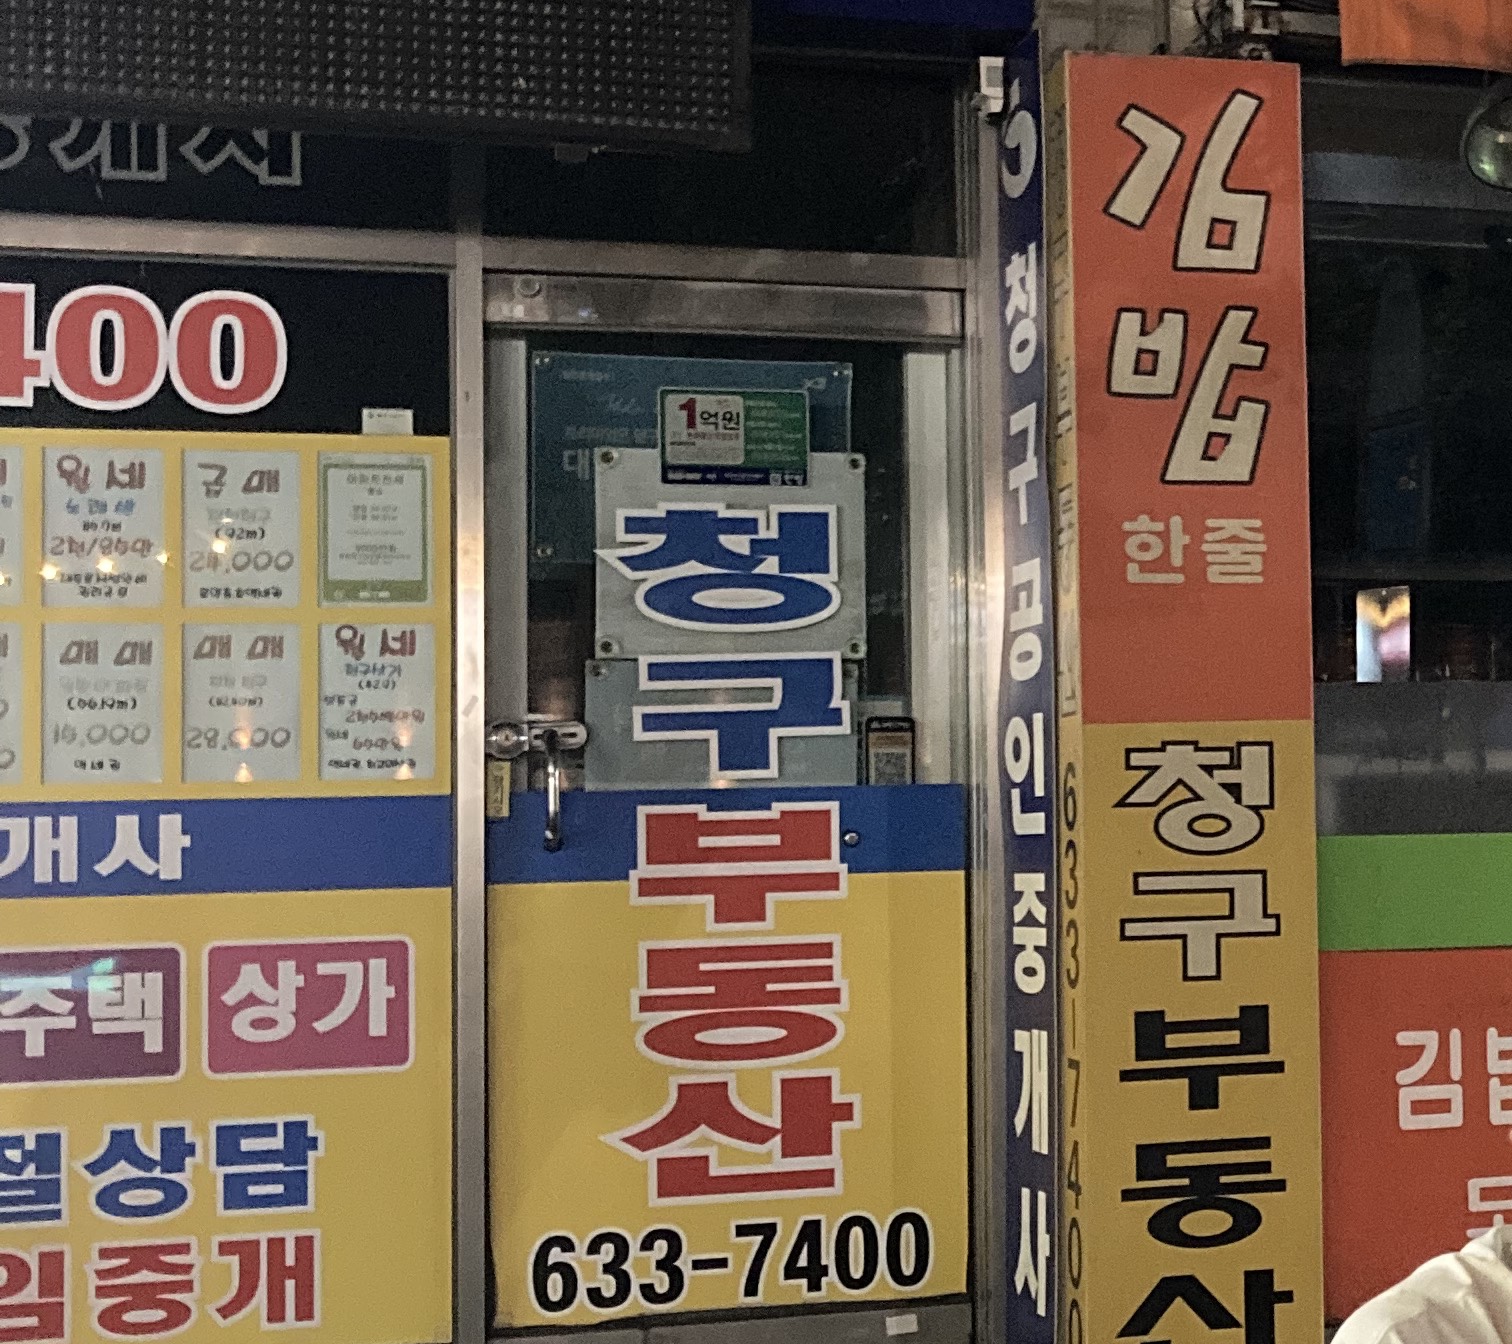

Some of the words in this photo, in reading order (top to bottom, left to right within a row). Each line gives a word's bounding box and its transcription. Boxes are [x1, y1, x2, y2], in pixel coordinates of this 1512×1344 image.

[1104, 86, 1272, 489] 김밥
[600, 499, 850, 779] 청구
[1121, 512, 1269, 587] 한줄
[1110, 737, 1284, 982] 청구
[220, 957, 397, 1044] 상가
[602, 799, 862, 1206] 부동산
[530, 1206, 934, 1315] 633-7400
